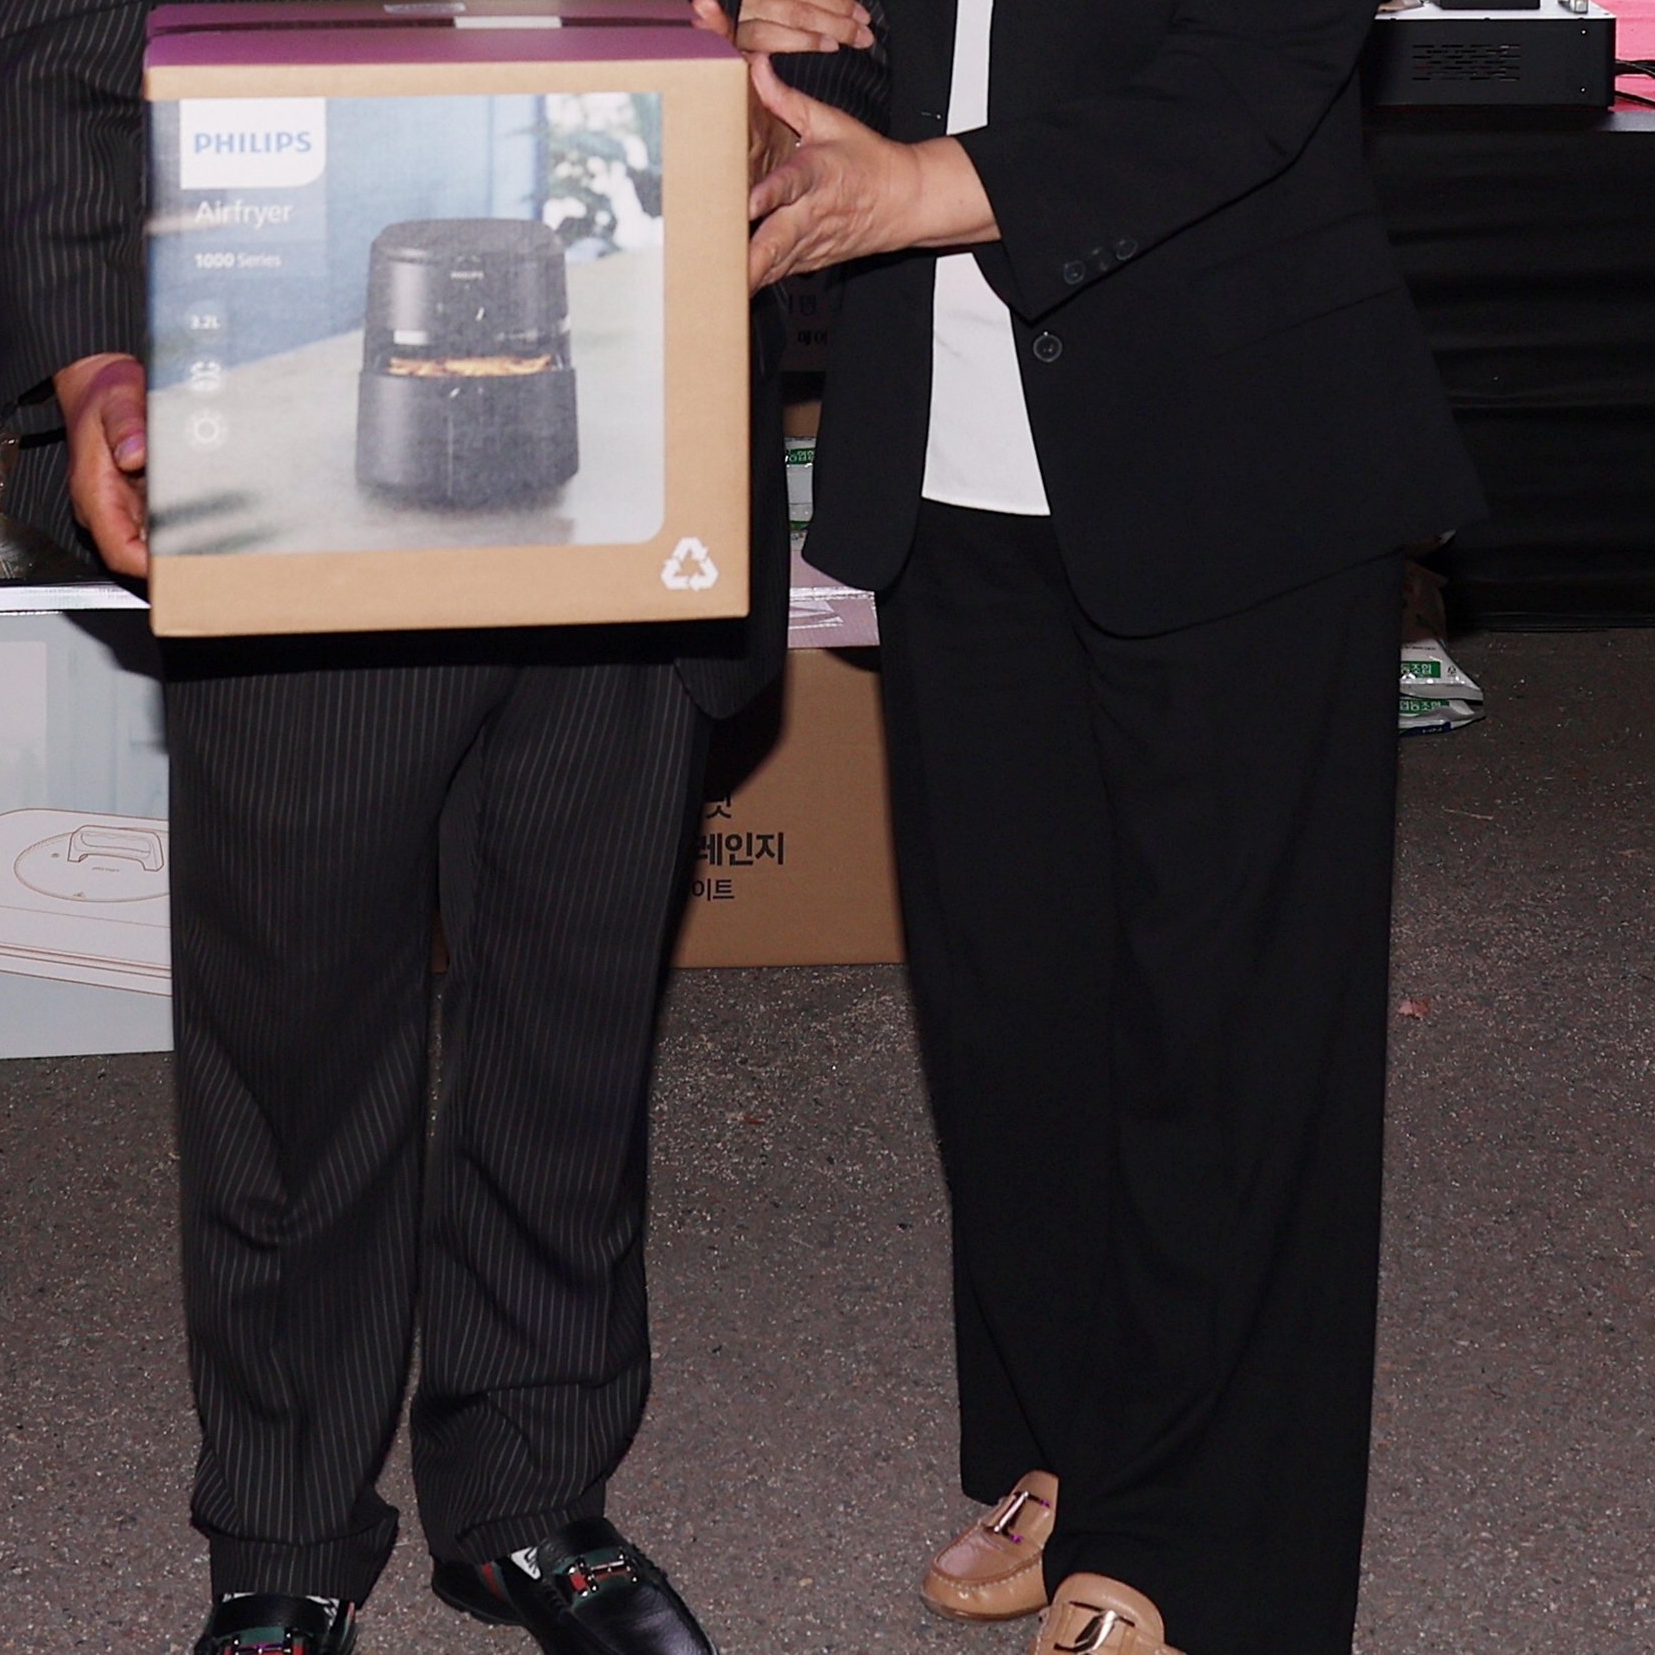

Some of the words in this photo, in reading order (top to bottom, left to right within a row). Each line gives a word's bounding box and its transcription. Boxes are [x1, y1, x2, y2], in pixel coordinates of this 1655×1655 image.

[194, 132, 311, 154] PHILIPS
[196, 201, 294, 227] Airfryer
[194, 253, 234, 268] 1000
[237, 254, 281, 268] Series
[696, 833, 784, 866] 레인지
[692, 878, 735, 901] 이트
